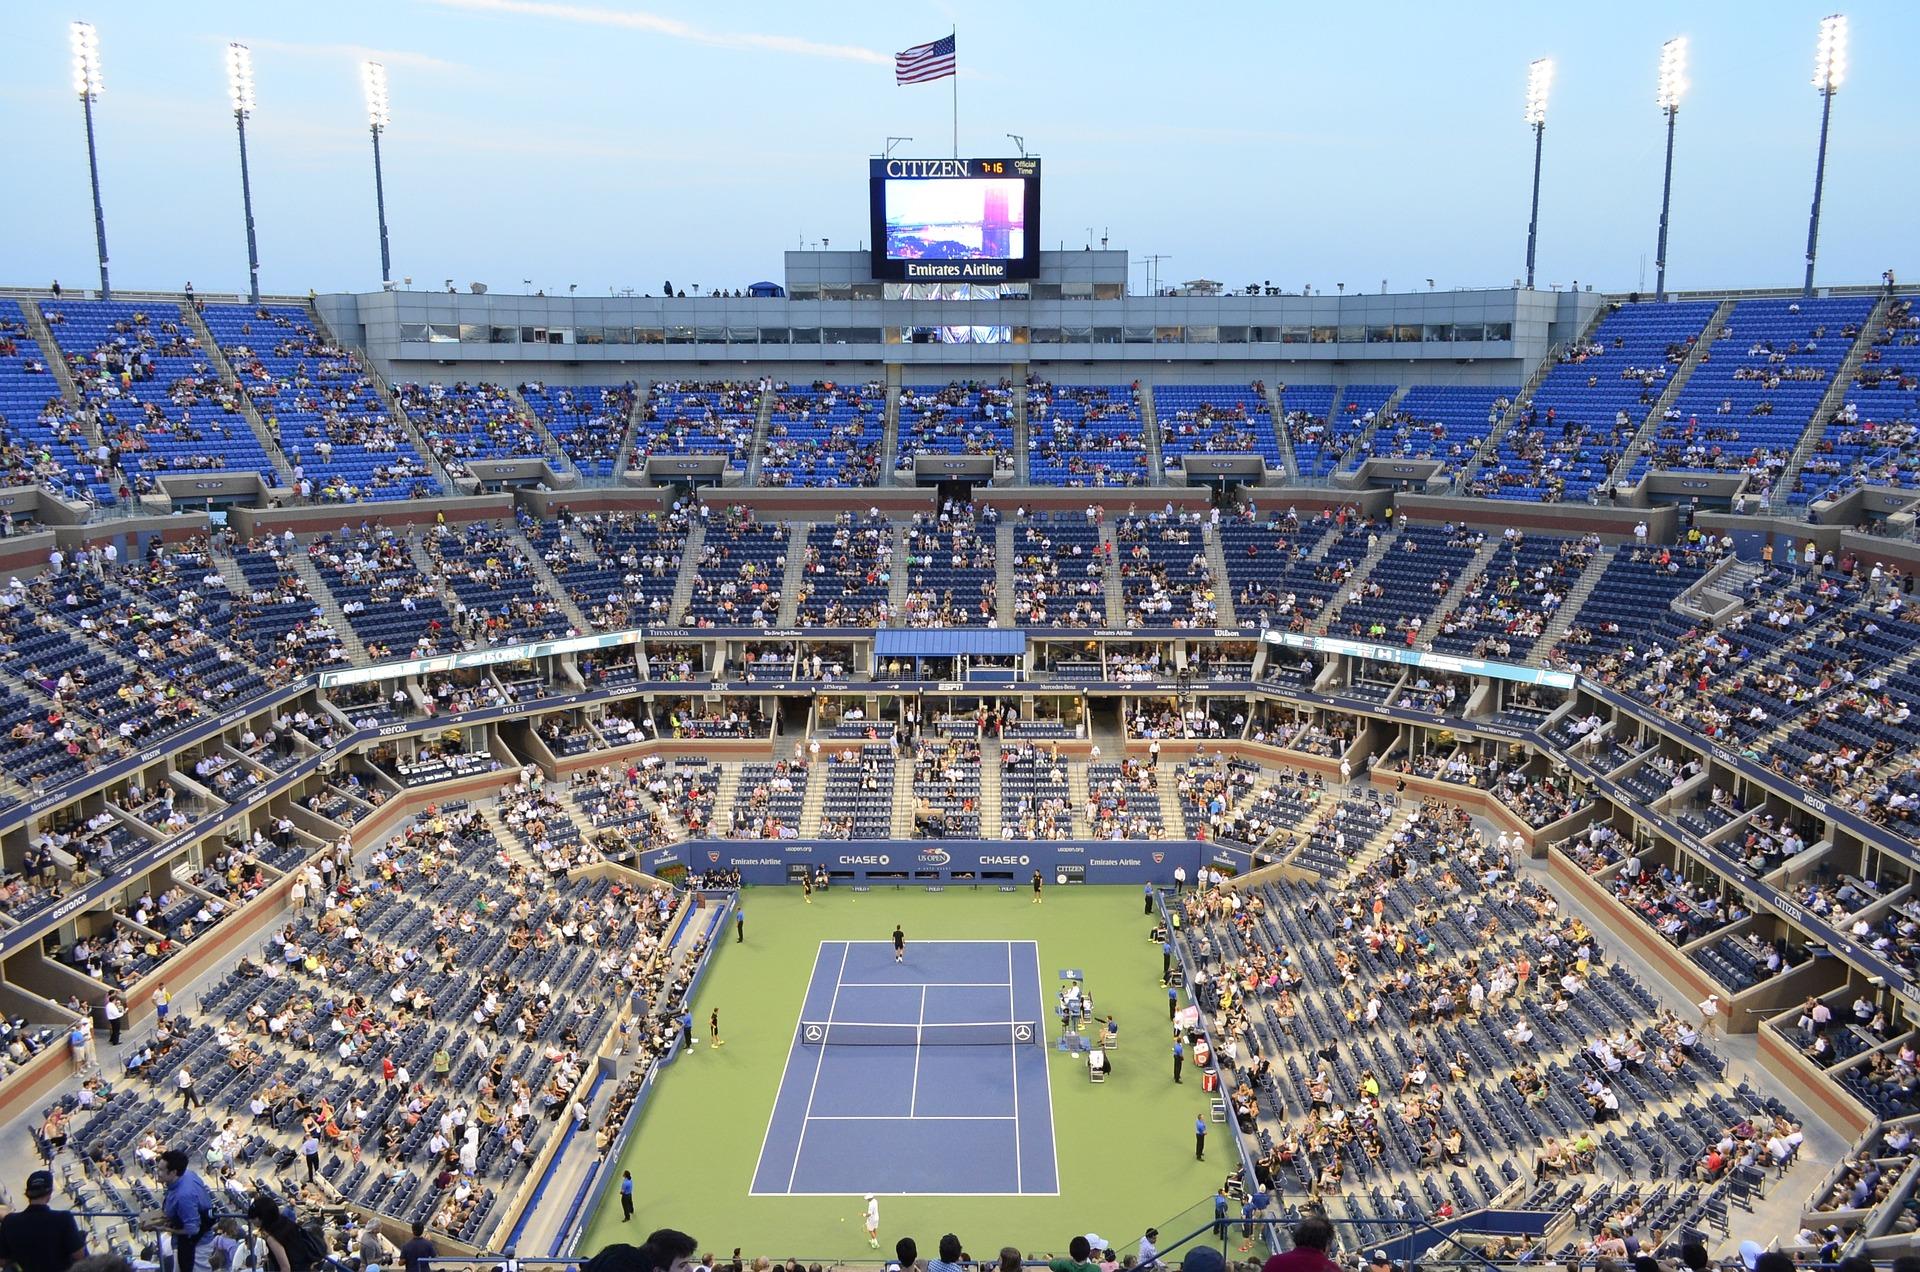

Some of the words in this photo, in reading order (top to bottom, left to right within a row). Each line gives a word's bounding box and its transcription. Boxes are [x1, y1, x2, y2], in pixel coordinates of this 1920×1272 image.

[887, 160, 970, 178] CITIZEN
[982, 162, 1003, 174] 7:16
[1014, 160, 1036, 169] Official
[1017, 167, 1033, 175] Time
[908, 264, 960, 276] Emirates
[963, 264, 1004, 276] Airline
[1214, 629, 1240, 637] Wilson
[711, 683, 728, 691] IBM
[938, 683, 964, 691] ESPN
[1374, 706, 1390, 714] evian
[379, 724, 408, 736] xerox
[1476, 724, 1488, 732] Time
[1488, 727, 1506, 735] Warner
[1614, 789, 1631, 807] CHASE
[1802, 793, 1826, 813] xerox
[153, 840, 177, 859] AMERICAN
[176, 831, 196, 846] EXPRESS
[839, 856, 878, 864] CHASE
[979, 856, 1018, 864] CHASE
[53, 894, 87, 919] esurance
[1774, 896, 1802, 922] CITIZEN
